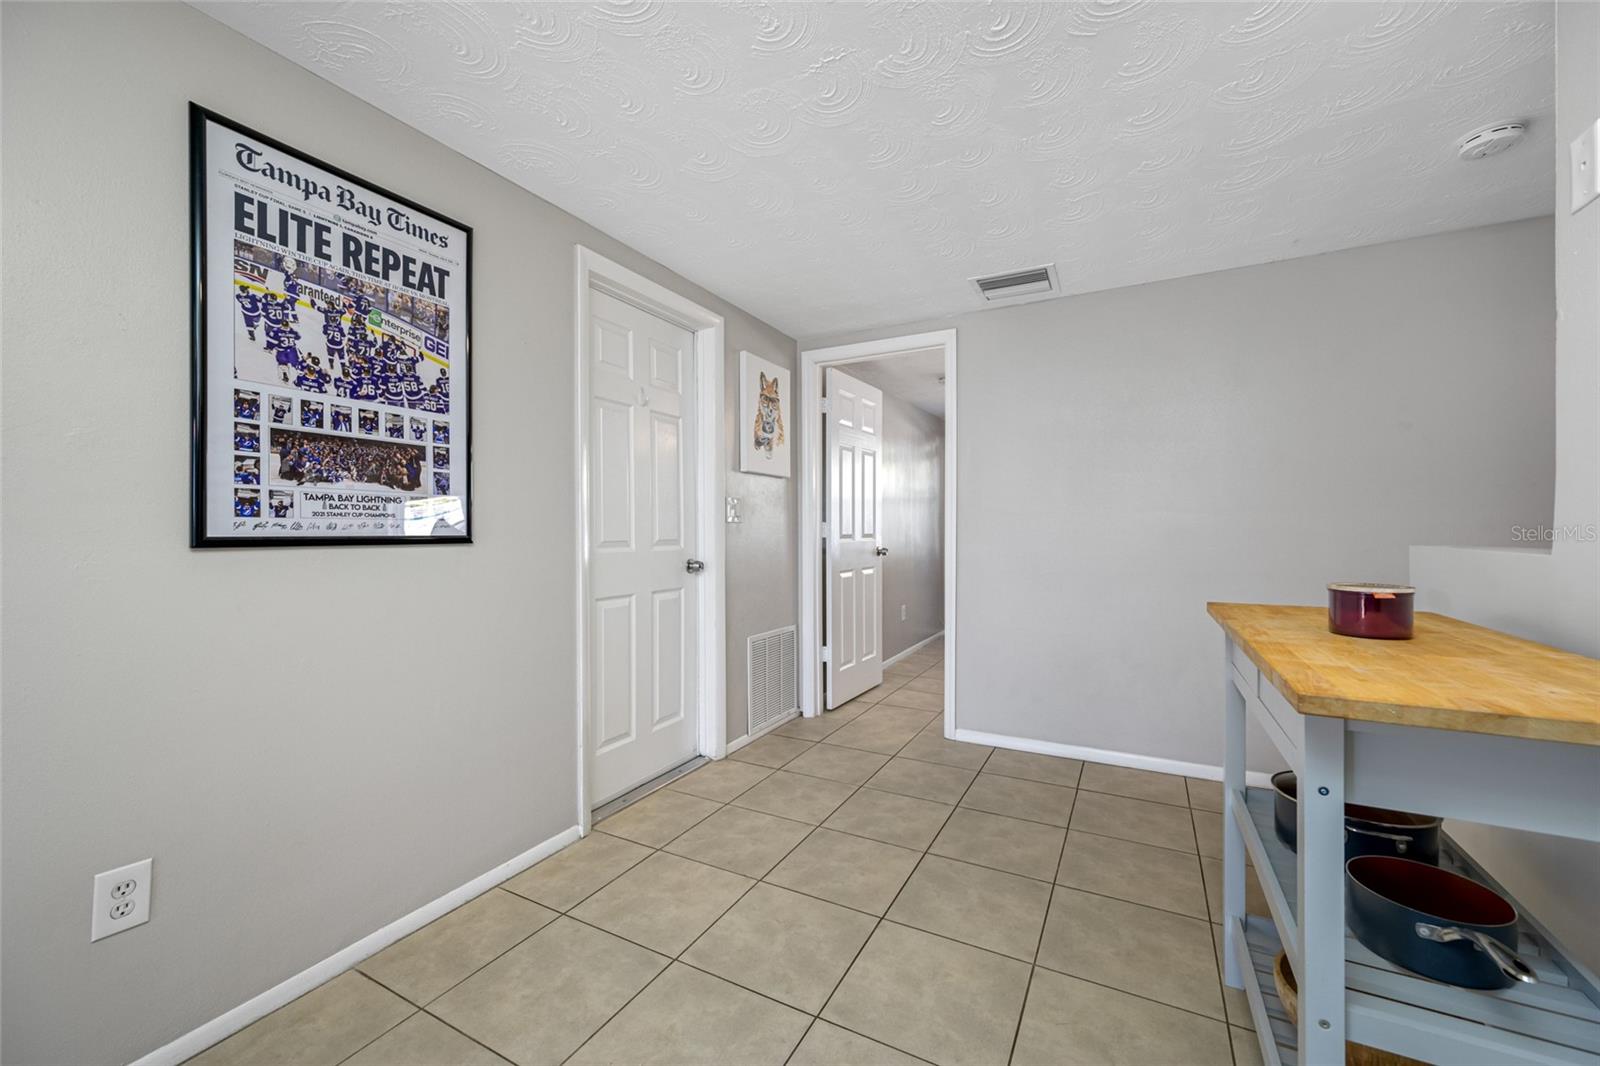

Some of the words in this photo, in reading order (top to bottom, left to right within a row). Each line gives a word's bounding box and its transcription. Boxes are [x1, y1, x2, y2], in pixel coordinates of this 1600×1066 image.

[234, 183, 258, 196] STANLEY
[235, 142, 332, 202] Tampa
[336, 185, 382, 227] Bay
[386, 207, 449, 249] Times
[234, 191, 332, 262] ELITE
[342, 232, 450, 300] REPEAT
[235, 232, 280, 252] LIGHTNING
[281, 247, 297, 257] WIN
[297, 252, 311, 262] THE
[312, 257, 328, 270] CUP
[268, 309, 283, 320] 20
[327, 330, 341, 342] 79
[404, 381, 418, 392] 58
[303, 492, 335, 502] TAMPA
[338, 494, 354, 503] BAY
[356, 495, 403, 505] LIGHTNING
[329, 503, 349, 511] BACK
[362, 504, 381, 512] BACK
